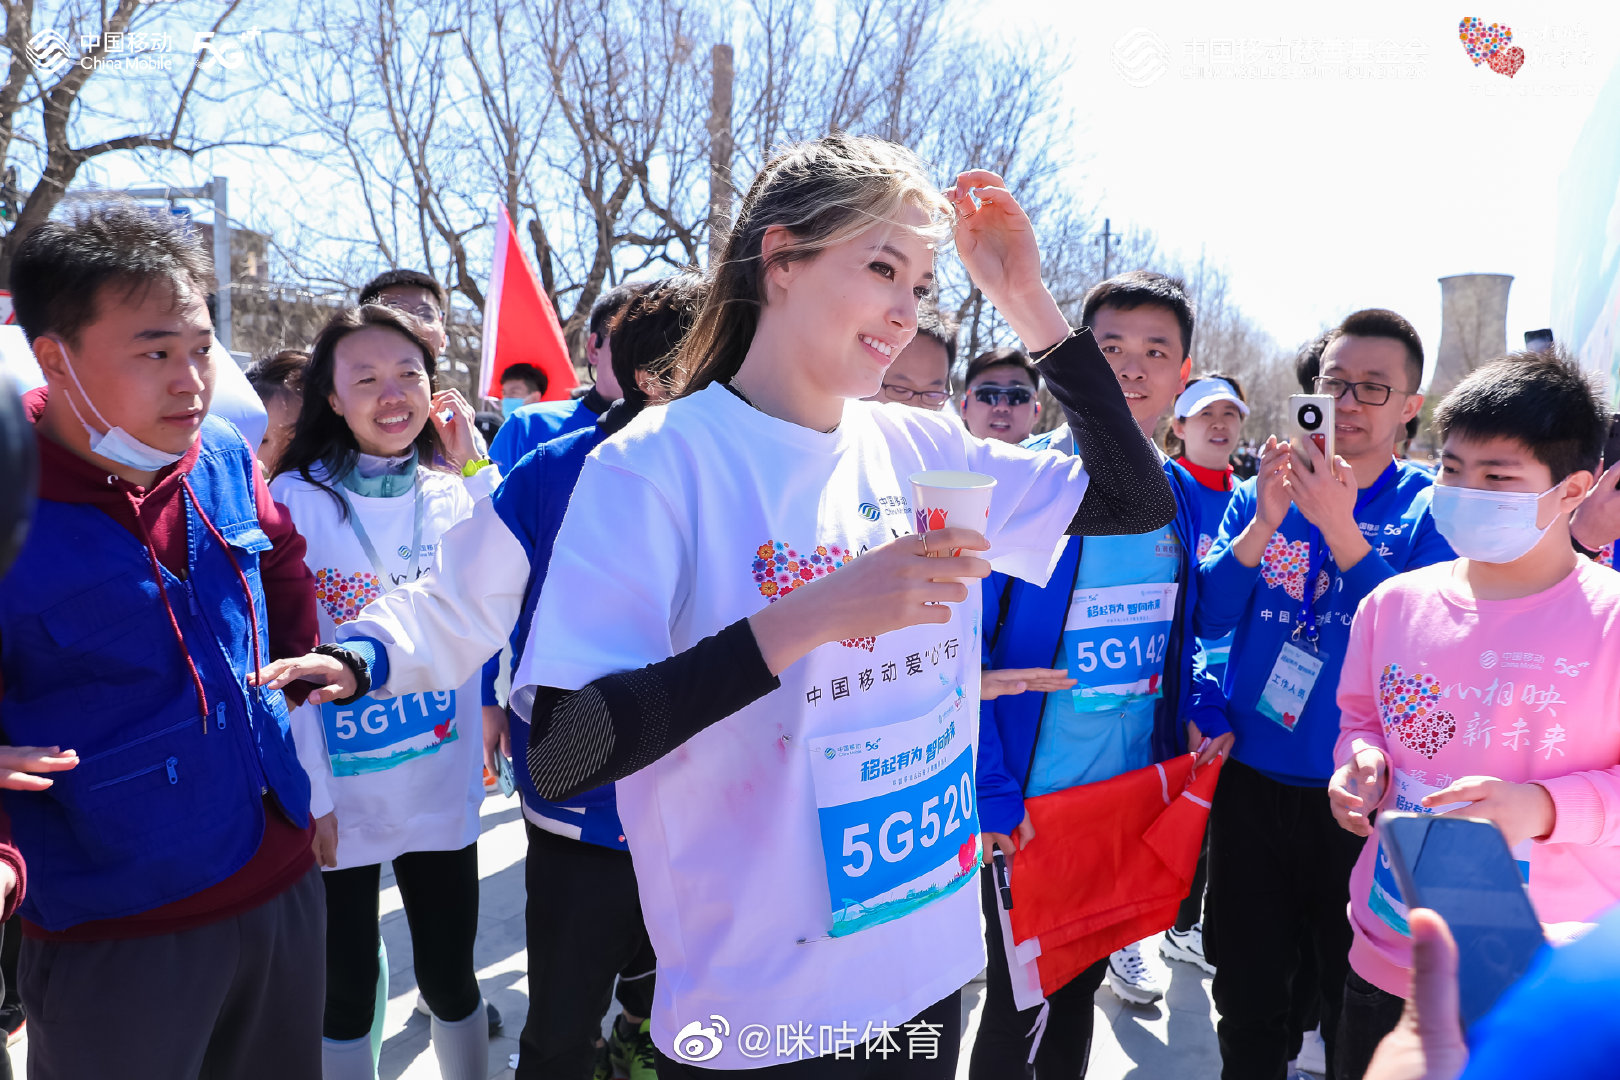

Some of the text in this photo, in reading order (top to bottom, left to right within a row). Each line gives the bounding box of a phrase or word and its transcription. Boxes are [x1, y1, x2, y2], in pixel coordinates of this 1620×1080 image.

[1087, 599, 1161, 618] 移起有为 智向未来
[1077, 633, 1165, 673] 5G142
[1502, 651, 1544, 664] 中国移动
[1272, 673, 1306, 700] 工作人员
[1443, 678, 1567, 718] 心相映
[335, 690, 452, 740] 5G119
[860, 746, 922, 782] 移起有为
[926, 720, 955, 764] 智向未来
[1463, 711, 1567, 760] 新未来
[842, 771, 973, 878] 5G520
